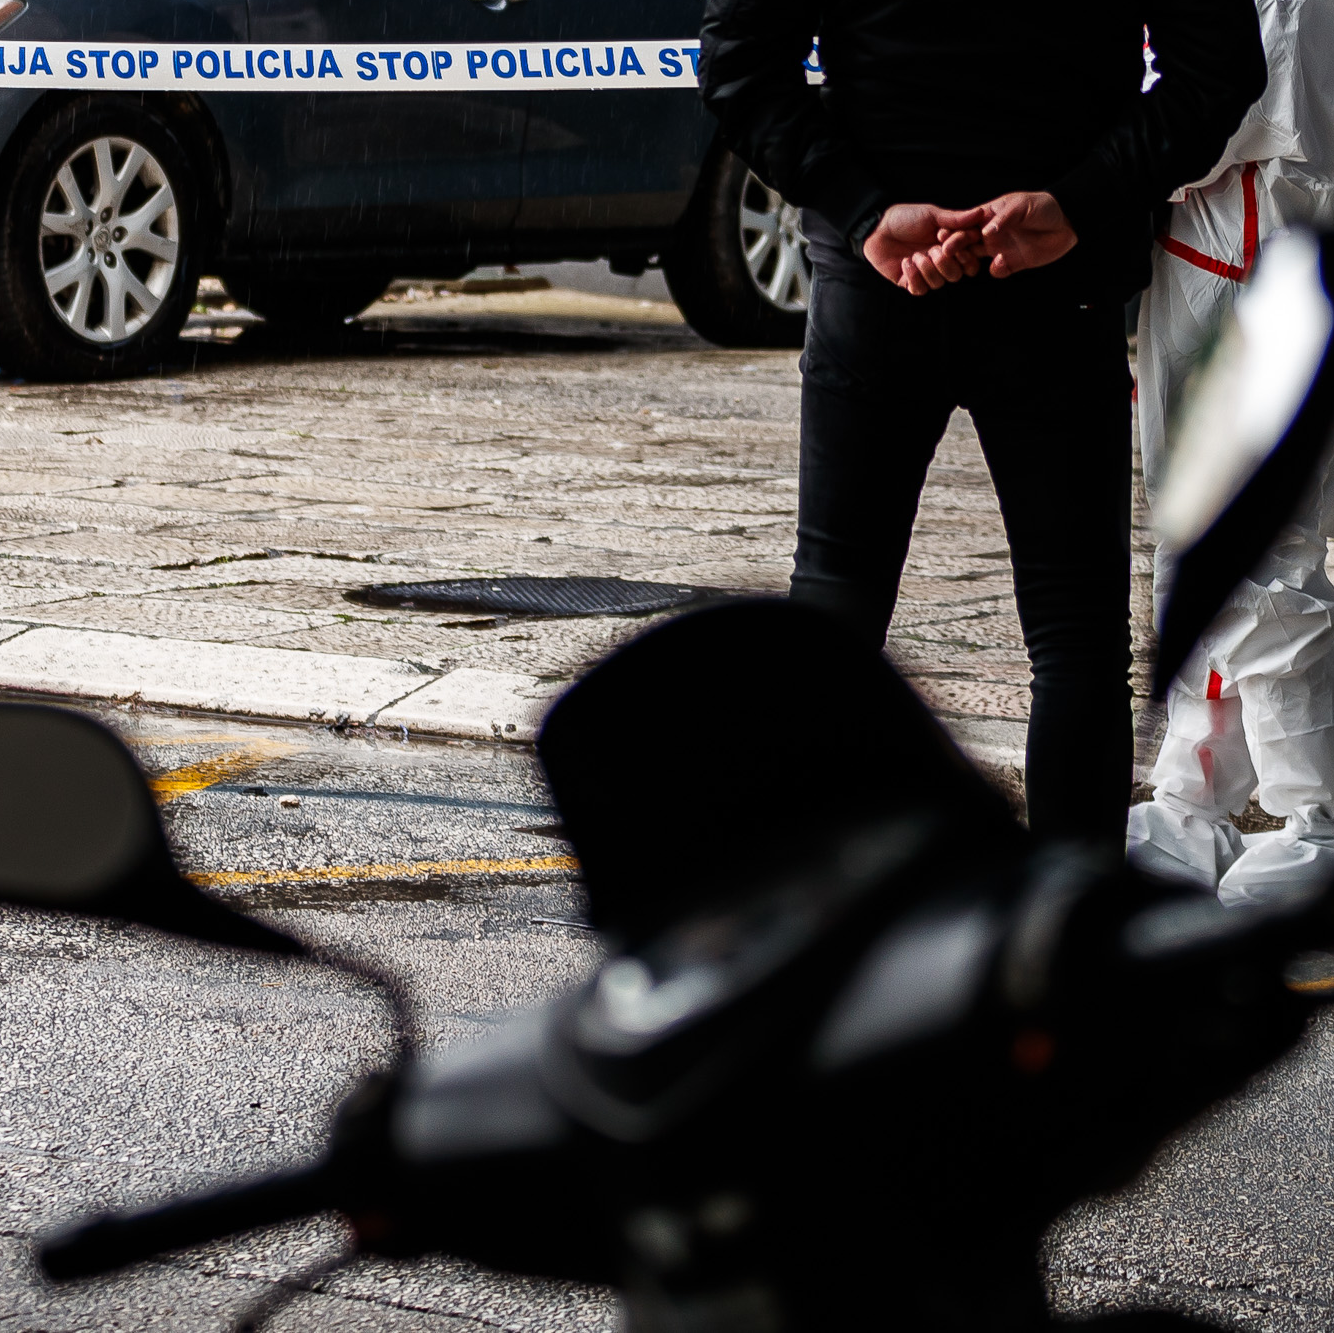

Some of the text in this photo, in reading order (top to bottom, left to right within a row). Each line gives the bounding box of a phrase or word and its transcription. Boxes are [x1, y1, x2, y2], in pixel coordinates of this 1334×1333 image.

[67, 50, 159, 79] STOP
[172, 49, 343, 79] POLICIJA
[356, 51, 452, 81] STOP
[467, 46, 645, 79] POLICIJA
